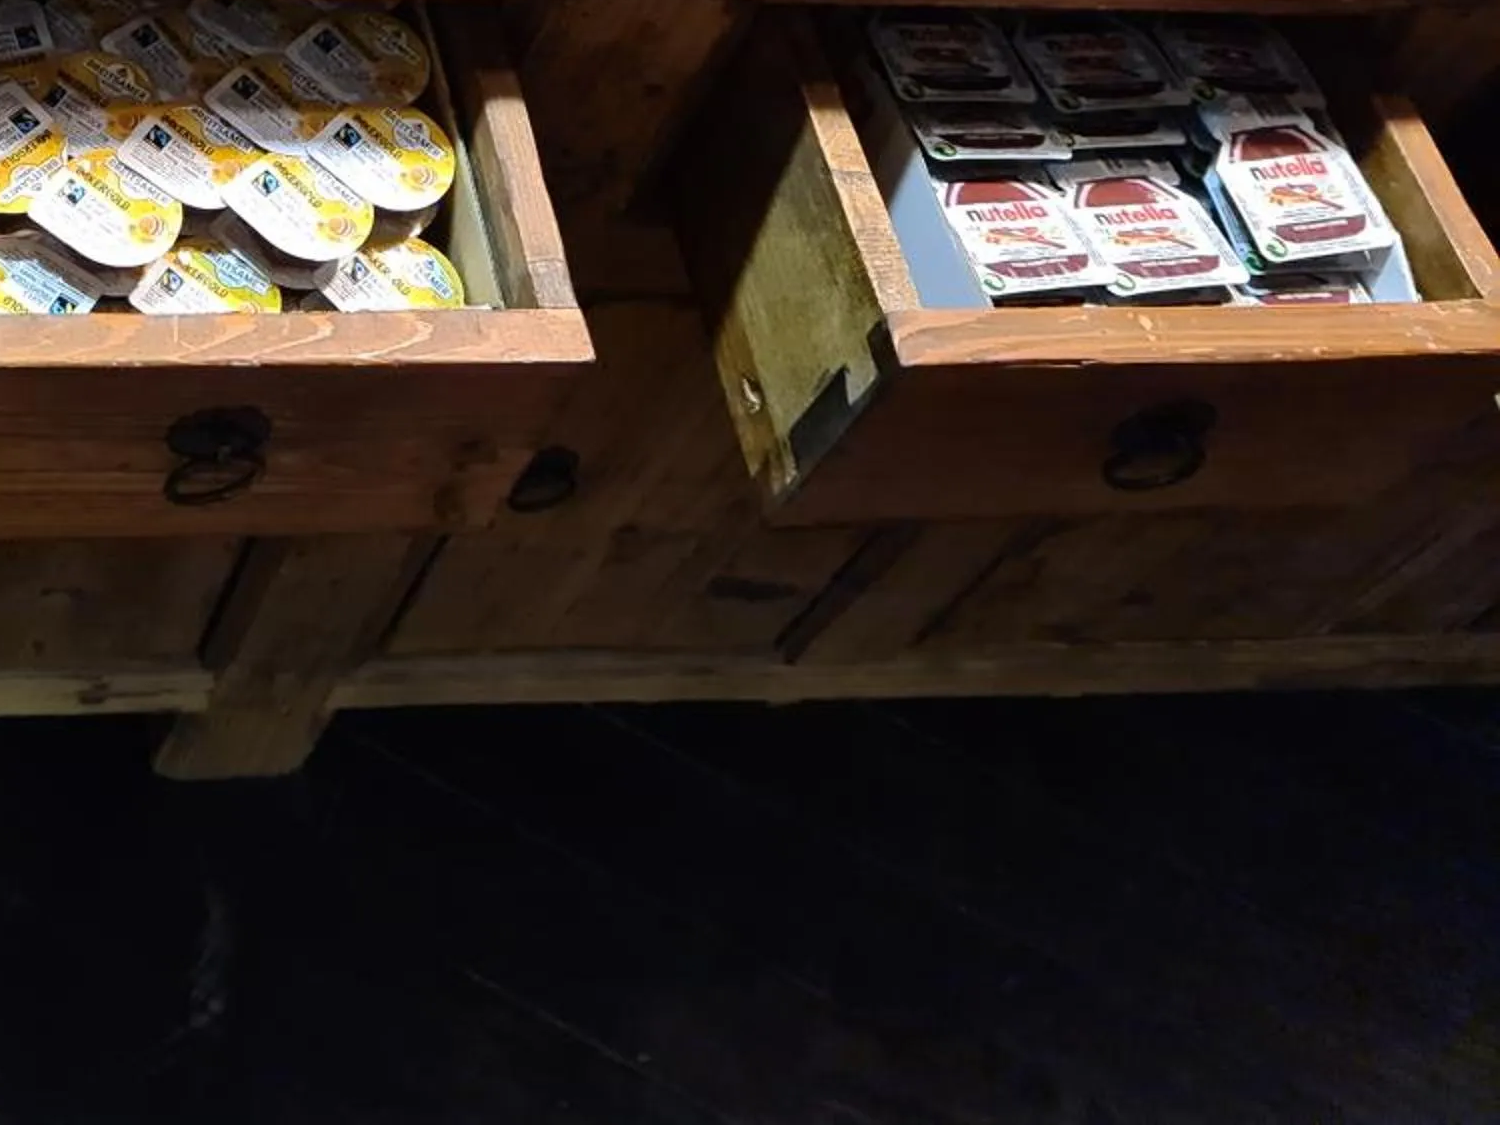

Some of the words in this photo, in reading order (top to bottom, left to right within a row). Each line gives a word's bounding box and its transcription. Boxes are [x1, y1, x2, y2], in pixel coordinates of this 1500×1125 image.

[1250, 153, 1328, 181] nutella
[966, 202, 1049, 223] nutella
[1094, 206, 1181, 225] nutella
